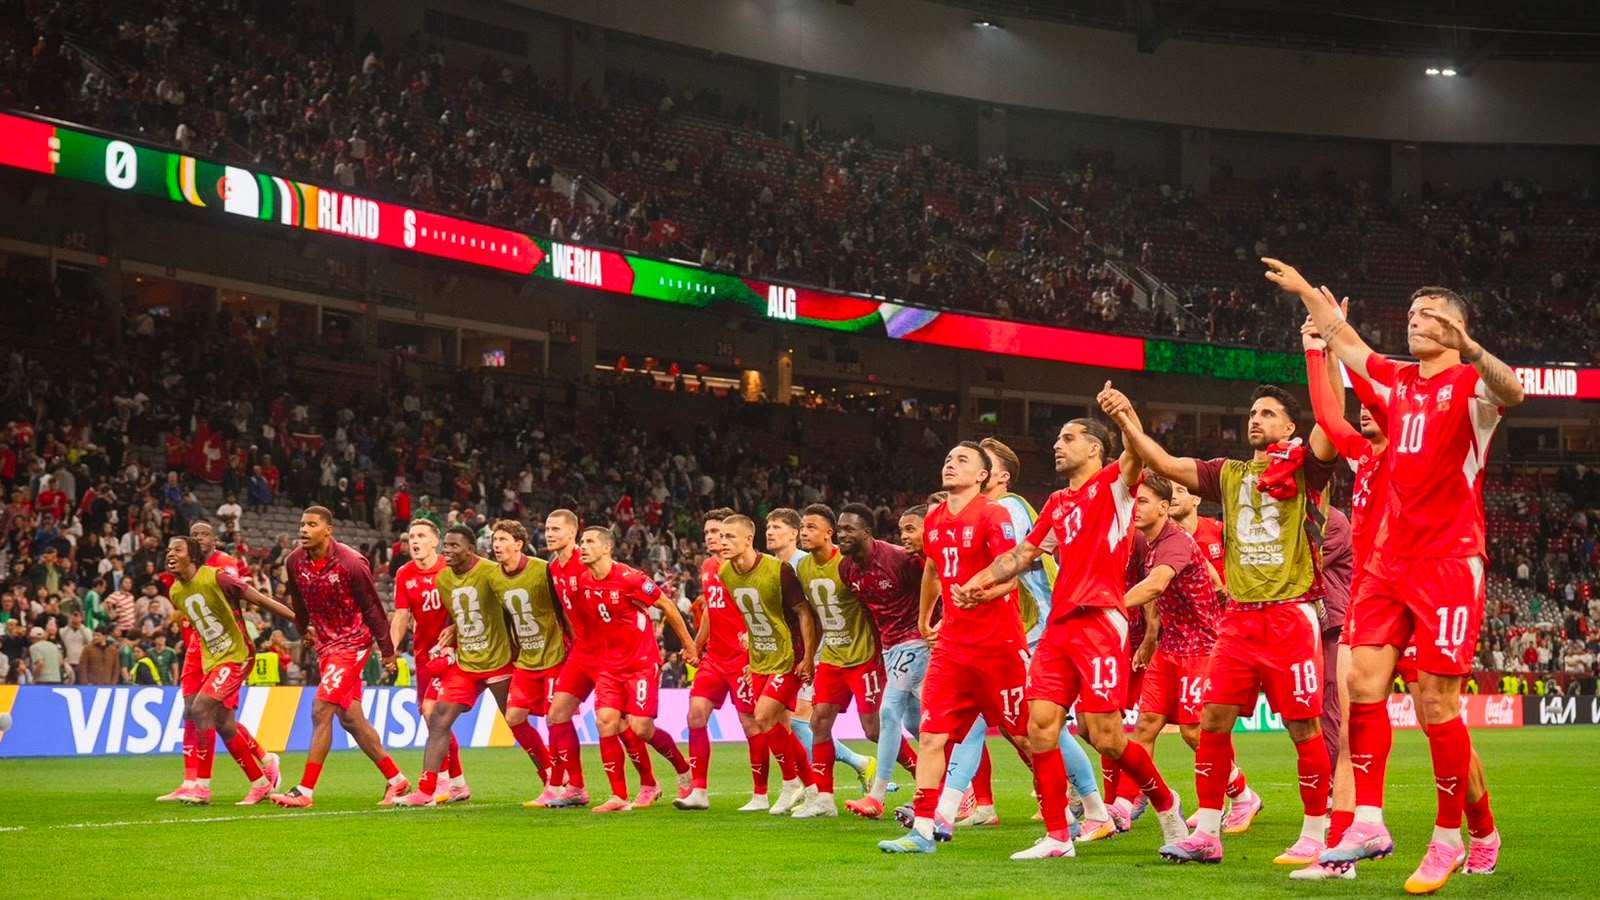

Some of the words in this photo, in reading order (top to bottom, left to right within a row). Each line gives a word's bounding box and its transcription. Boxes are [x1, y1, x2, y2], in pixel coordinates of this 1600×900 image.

[105, 140, 137, 189] 0
[317, 189, 379, 240] RLAND
[767, 285, 797, 320] ALG
[1397, 413, 1425, 453] 10
[1063, 507, 1082, 545] 13
[942, 547, 959, 578] 17
[421, 588, 442, 612] 20
[707, 586, 726, 608] 22
[598, 603, 612, 623] 8
[1434, 606, 1468, 647] 10
[215, 666, 231, 686] 9
[321, 663, 344, 689] 24
[893, 650, 916, 673] 12
[1091, 656, 1118, 690] 13
[636, 679, 648, 702] 8
[862, 670, 881, 696] 11
[1179, 676, 1201, 703] 14
[1289, 659, 1318, 696] 18
[1000, 686, 1024, 716] 17
